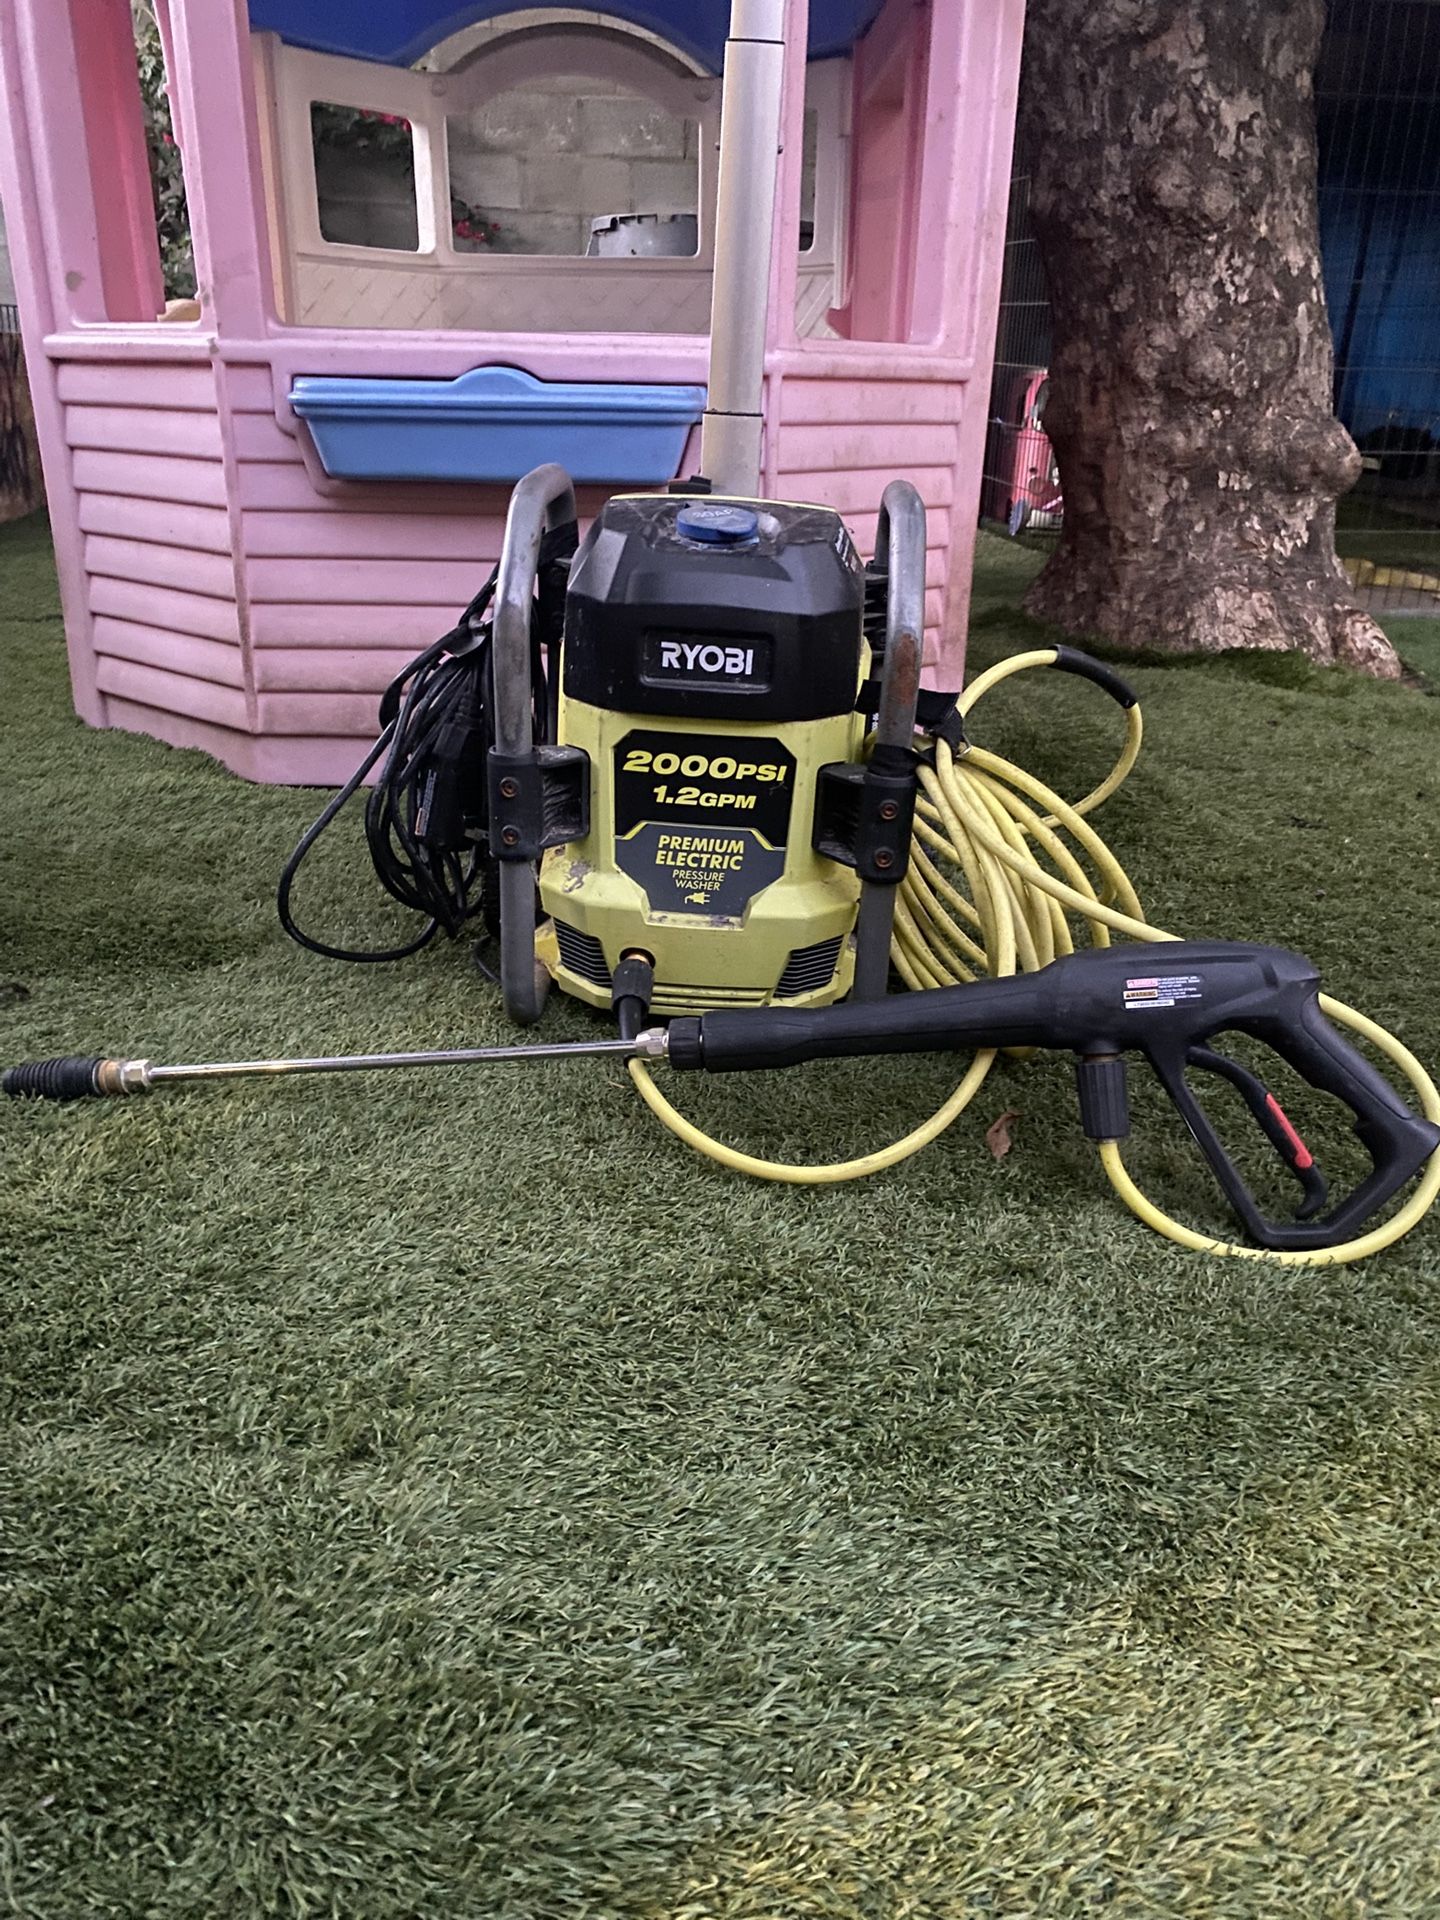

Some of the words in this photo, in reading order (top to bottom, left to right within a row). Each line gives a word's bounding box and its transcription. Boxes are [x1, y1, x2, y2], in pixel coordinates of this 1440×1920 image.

[661, 641, 754, 675] RYOBI
[623, 750, 787, 782] 2000PSI
[653, 785, 757, 809] 1.2GPM
[658, 835, 744, 854] PREMIUM
[655, 851, 743, 870] ELECTRIC
[672, 869, 725, 882] PRESSURE
[675, 879, 720, 891] WASHER
